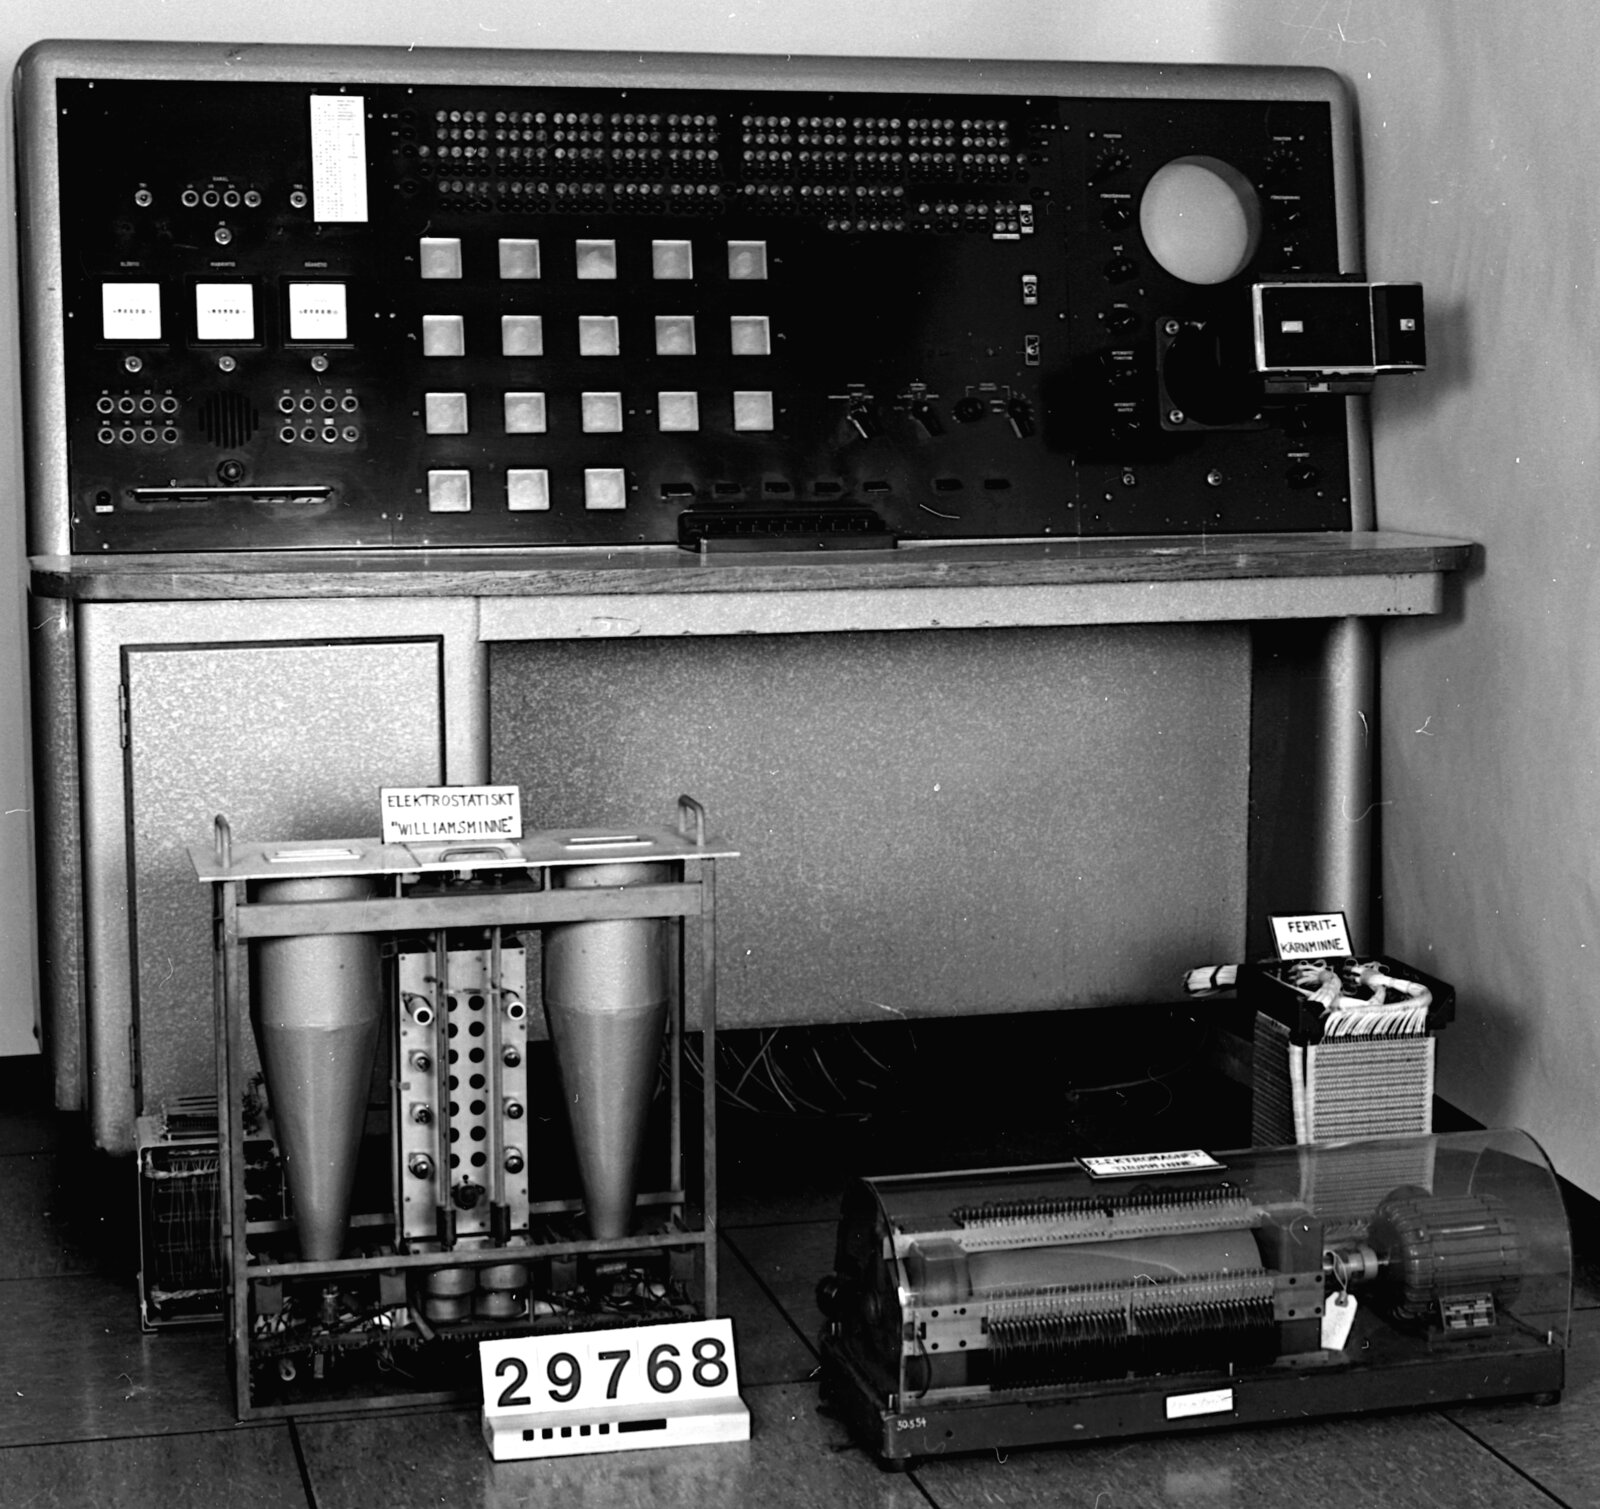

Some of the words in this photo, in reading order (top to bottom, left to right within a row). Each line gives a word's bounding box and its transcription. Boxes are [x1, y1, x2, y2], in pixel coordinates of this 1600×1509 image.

[388, 793, 514, 807] ELEKTROSTATISKT
[1288, 919, 1337, 933] FERRIT-
[495, 1337, 729, 1408] 29768
